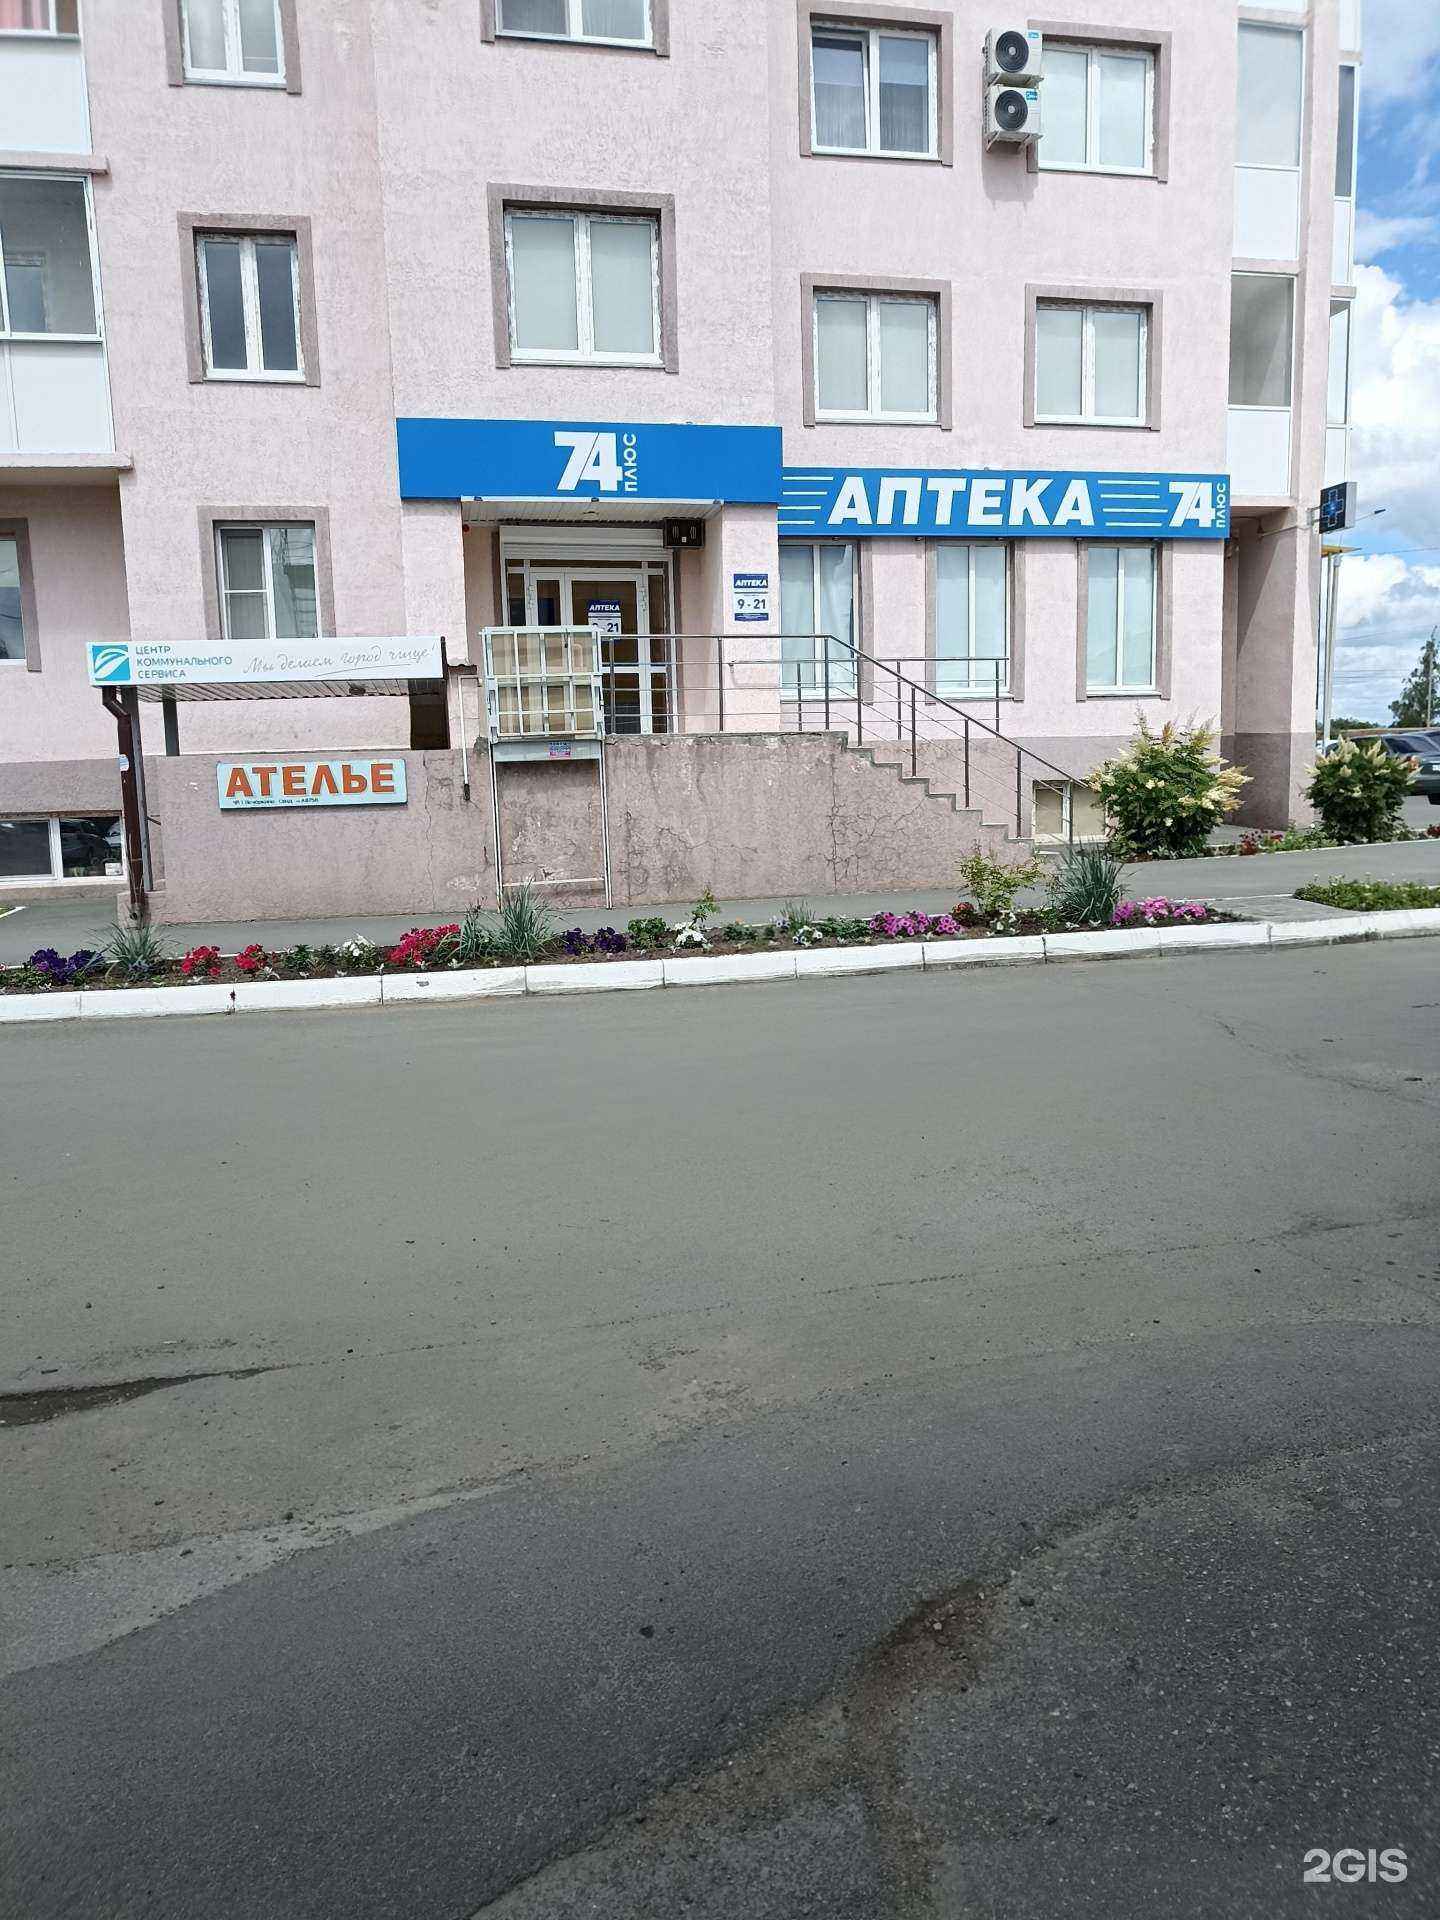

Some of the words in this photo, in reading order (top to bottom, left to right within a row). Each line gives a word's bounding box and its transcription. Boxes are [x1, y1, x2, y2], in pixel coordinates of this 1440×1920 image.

[553, 431, 623, 491] 74
[622, 432, 638, 492] ПЛЮС
[827, 476, 1095, 526] АПТЕКА
[1168, 481, 1216, 528] 74
[1216, 482, 1226, 528] ПЛЮС
[735, 579, 768, 587] АПТЕКА
[737, 598, 745, 610] 9
[753, 598, 766, 610] 21
[606, 622, 619, 632] 21
[135, 645, 171, 655] ЦЕНТР
[136, 656, 233, 667] КОММУНАЛЬНОГО
[137, 669, 187, 679] СЕРВИСА
[226, 763, 395, 797] АТЕЛЬЕ
